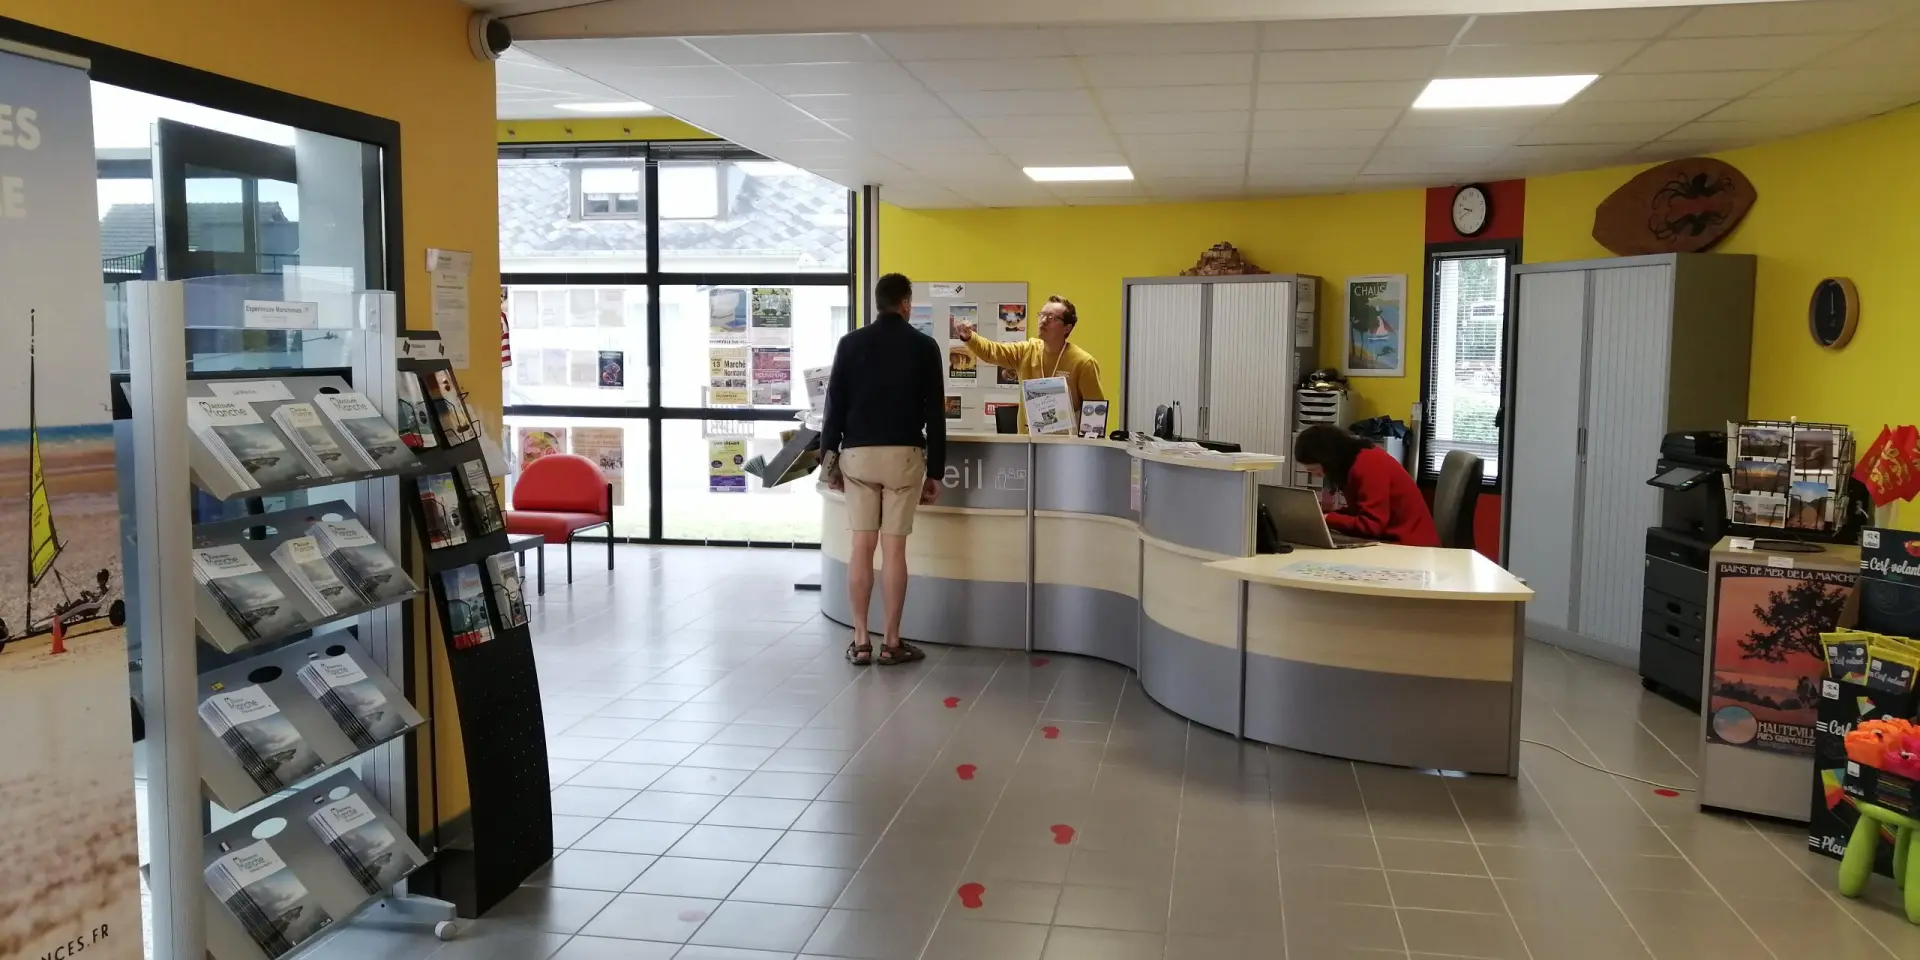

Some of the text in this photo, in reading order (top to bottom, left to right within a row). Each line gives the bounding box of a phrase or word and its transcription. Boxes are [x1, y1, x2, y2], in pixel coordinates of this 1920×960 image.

[0, 175, 27, 219] E
[1721, 564, 1857, 584] BAINS DE MER DE LA MANCHE
